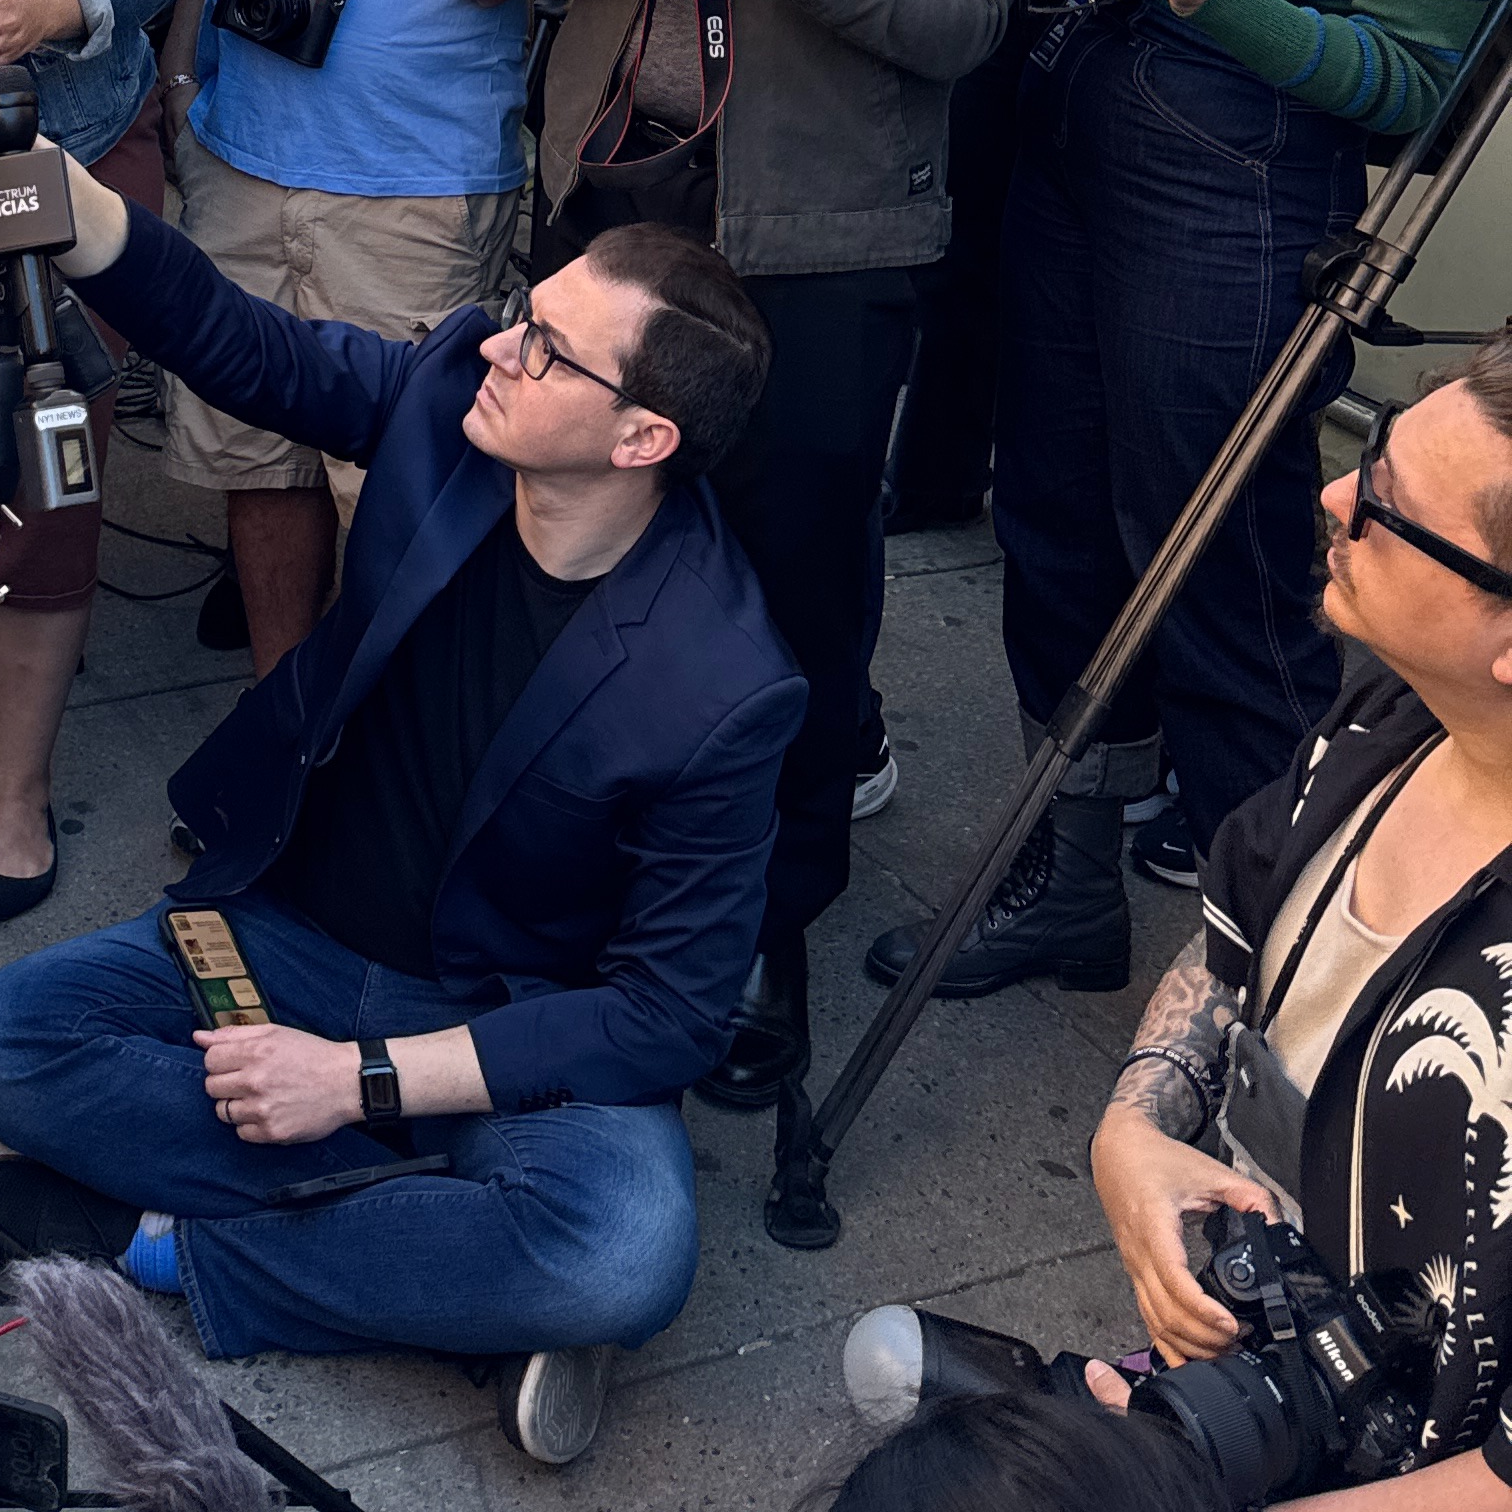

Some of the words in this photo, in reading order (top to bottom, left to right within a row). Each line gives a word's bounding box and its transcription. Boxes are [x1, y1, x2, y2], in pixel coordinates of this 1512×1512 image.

[707, 15, 725, 58] EOS
[56, 409, 82, 422] NEWS
[1316, 1330, 1354, 1382] Nikon
